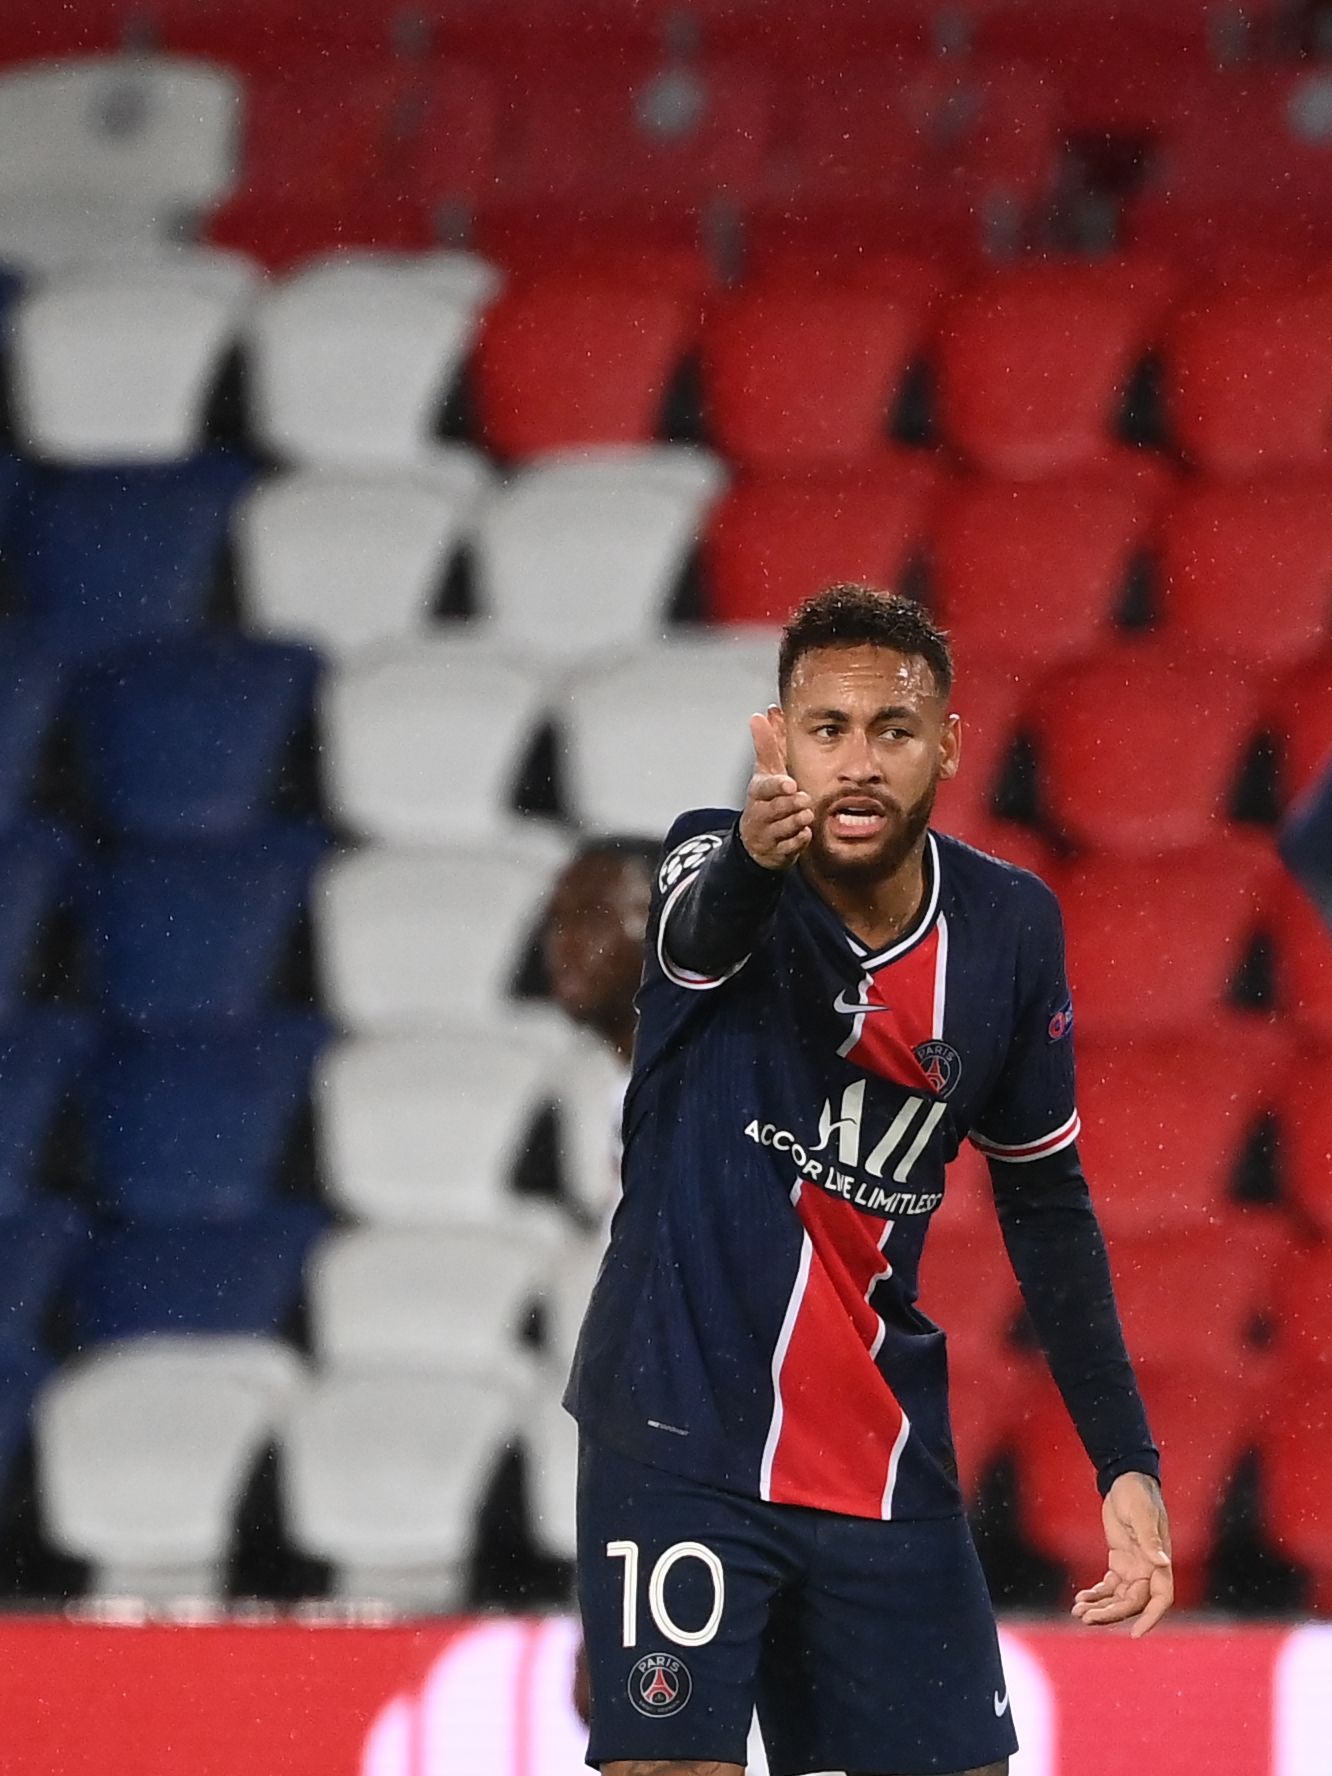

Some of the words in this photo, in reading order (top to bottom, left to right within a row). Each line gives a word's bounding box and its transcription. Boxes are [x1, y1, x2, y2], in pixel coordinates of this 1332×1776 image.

[916, 1045, 954, 1061] PARIS
[744, 1120, 823, 1180] ACCOR
[606, 1541, 724, 1647] 10
[638, 1656, 680, 1673] PARIS
